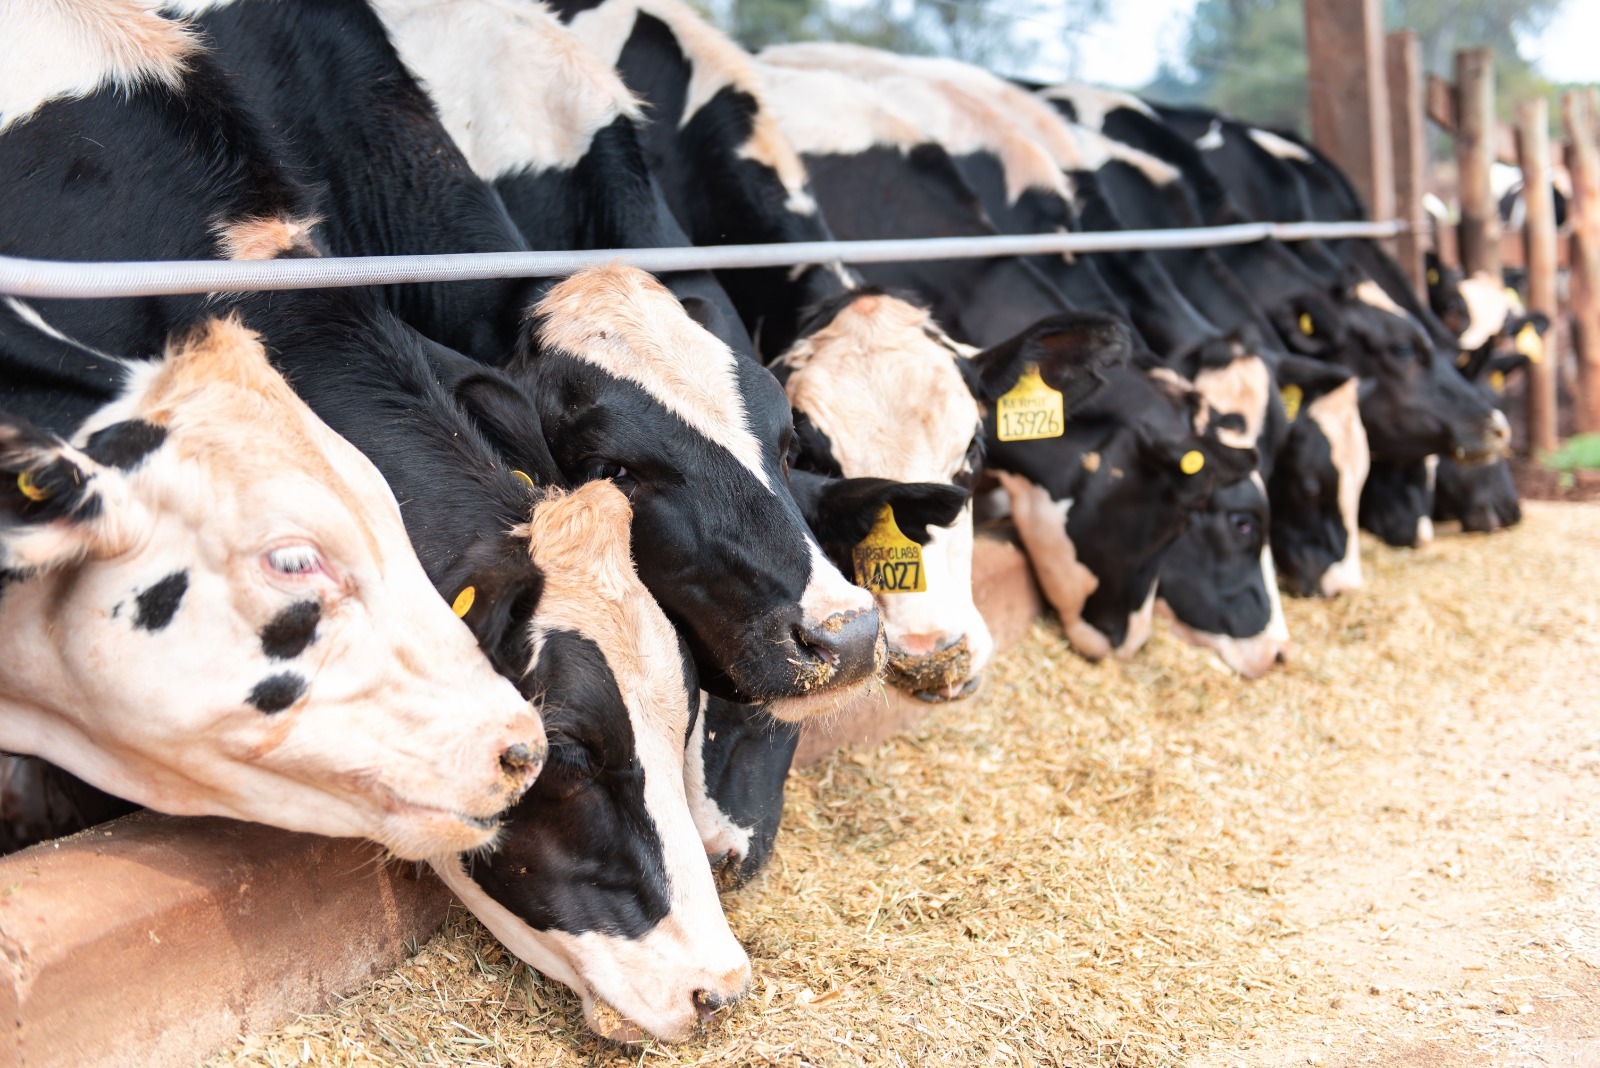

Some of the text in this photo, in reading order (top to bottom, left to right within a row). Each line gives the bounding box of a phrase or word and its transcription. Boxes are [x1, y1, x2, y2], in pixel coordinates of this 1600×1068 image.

[1002, 409, 1060, 437] 13926
[888, 546, 920, 560] CLASS
[858, 561, 920, 592] 14027
